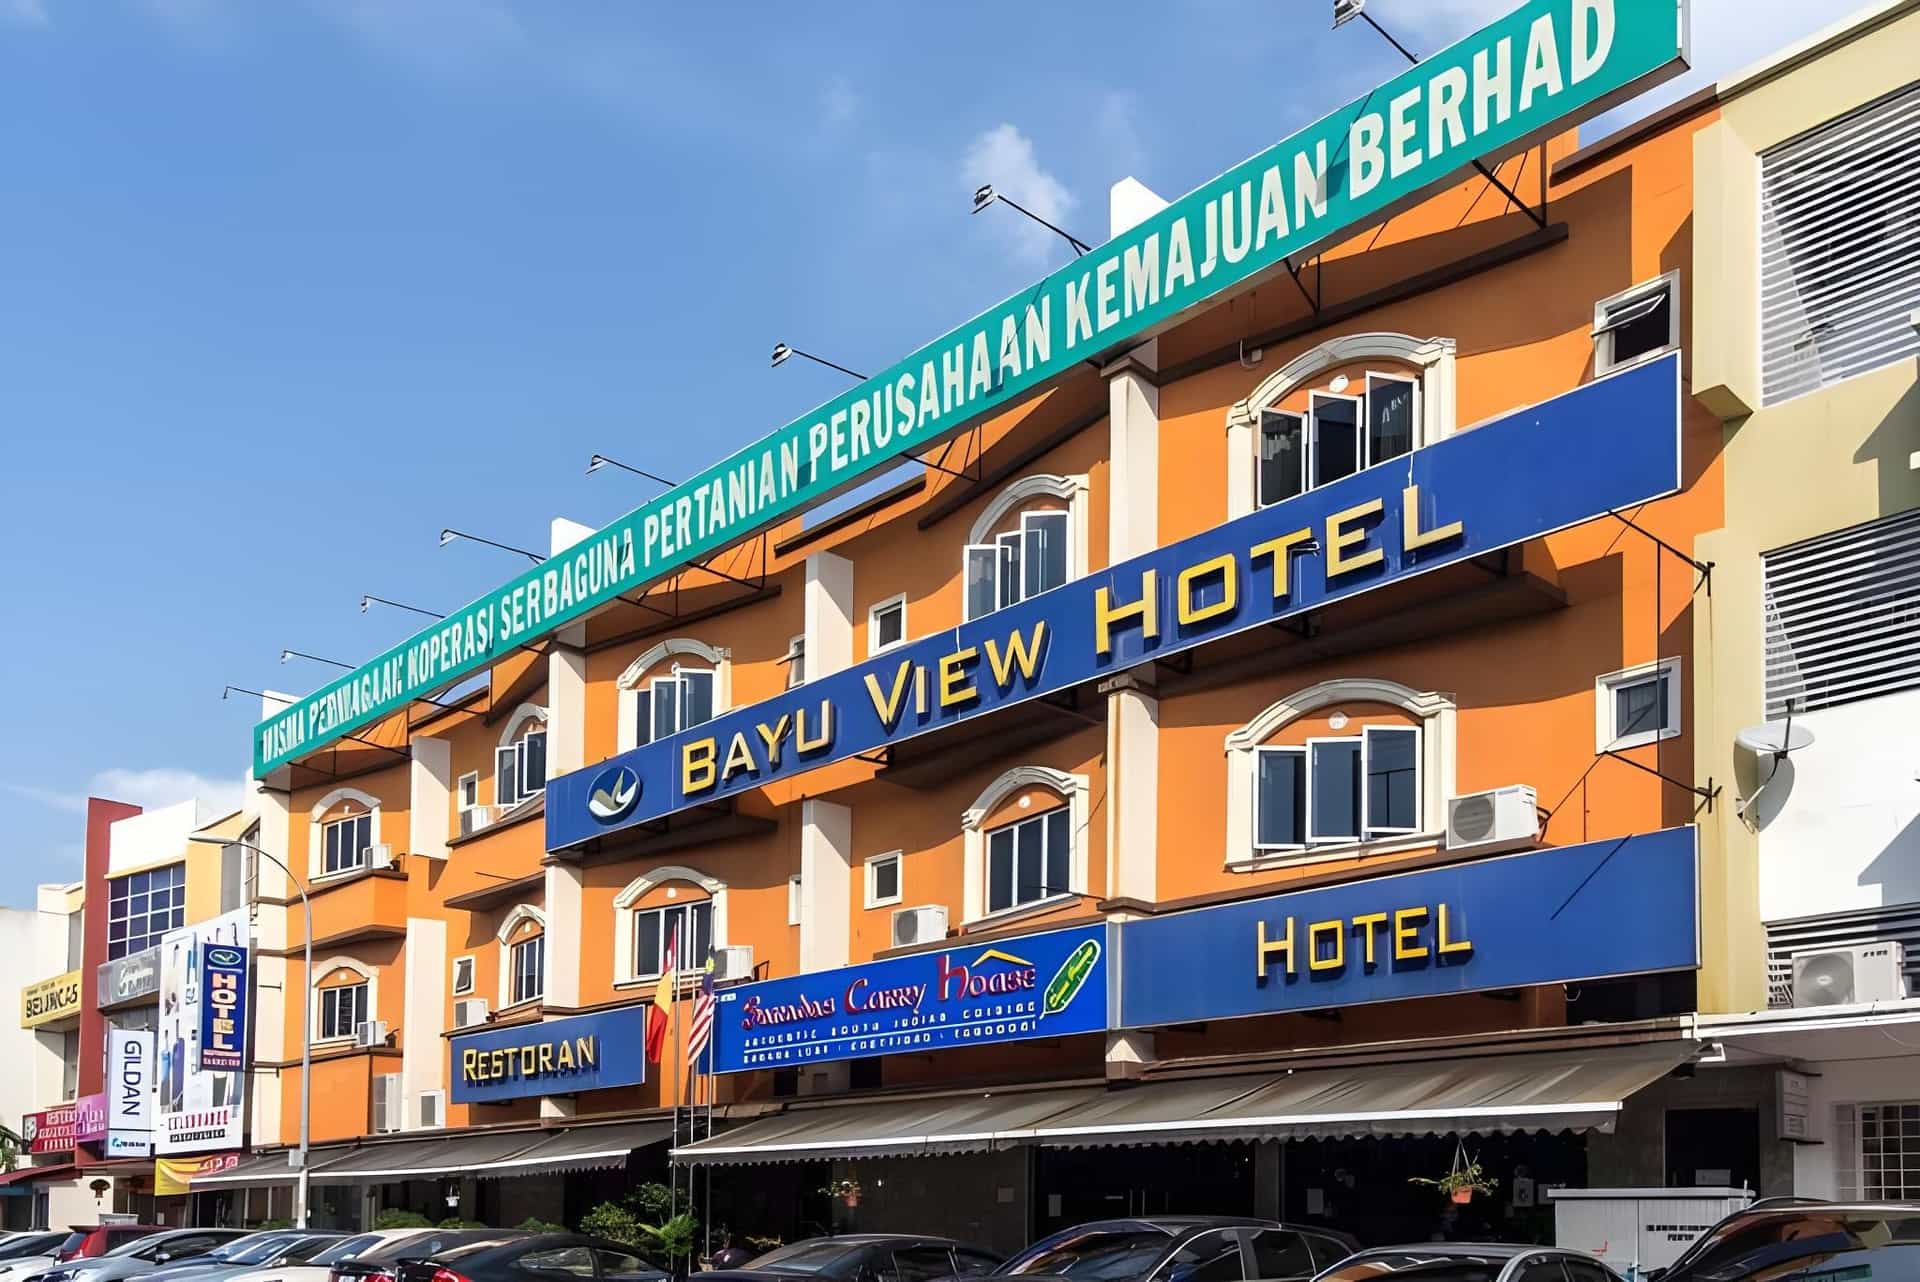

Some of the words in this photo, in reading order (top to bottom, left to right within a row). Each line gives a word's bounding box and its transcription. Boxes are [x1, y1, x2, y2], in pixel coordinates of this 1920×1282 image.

[500, 528, 635, 640] SERBAGUNA
[644, 436, 798, 567] PERTANIAN
[809, 297, 1051, 483] PERUSAHAAN
[1066, 139, 1328, 349] KEMAJUAN
[1349, 0, 1616, 200] BERHAD
[682, 699, 834, 796] BAYU
[865, 619, 1051, 727] VIEW
[1095, 484, 1464, 655] HOTEL
[1256, 903, 1474, 977] HOTEL
[211, 973, 236, 1049] HOTEL
[122, 1040, 142, 1116] GILDAN
[463, 1035, 594, 1082] RESTORAN
